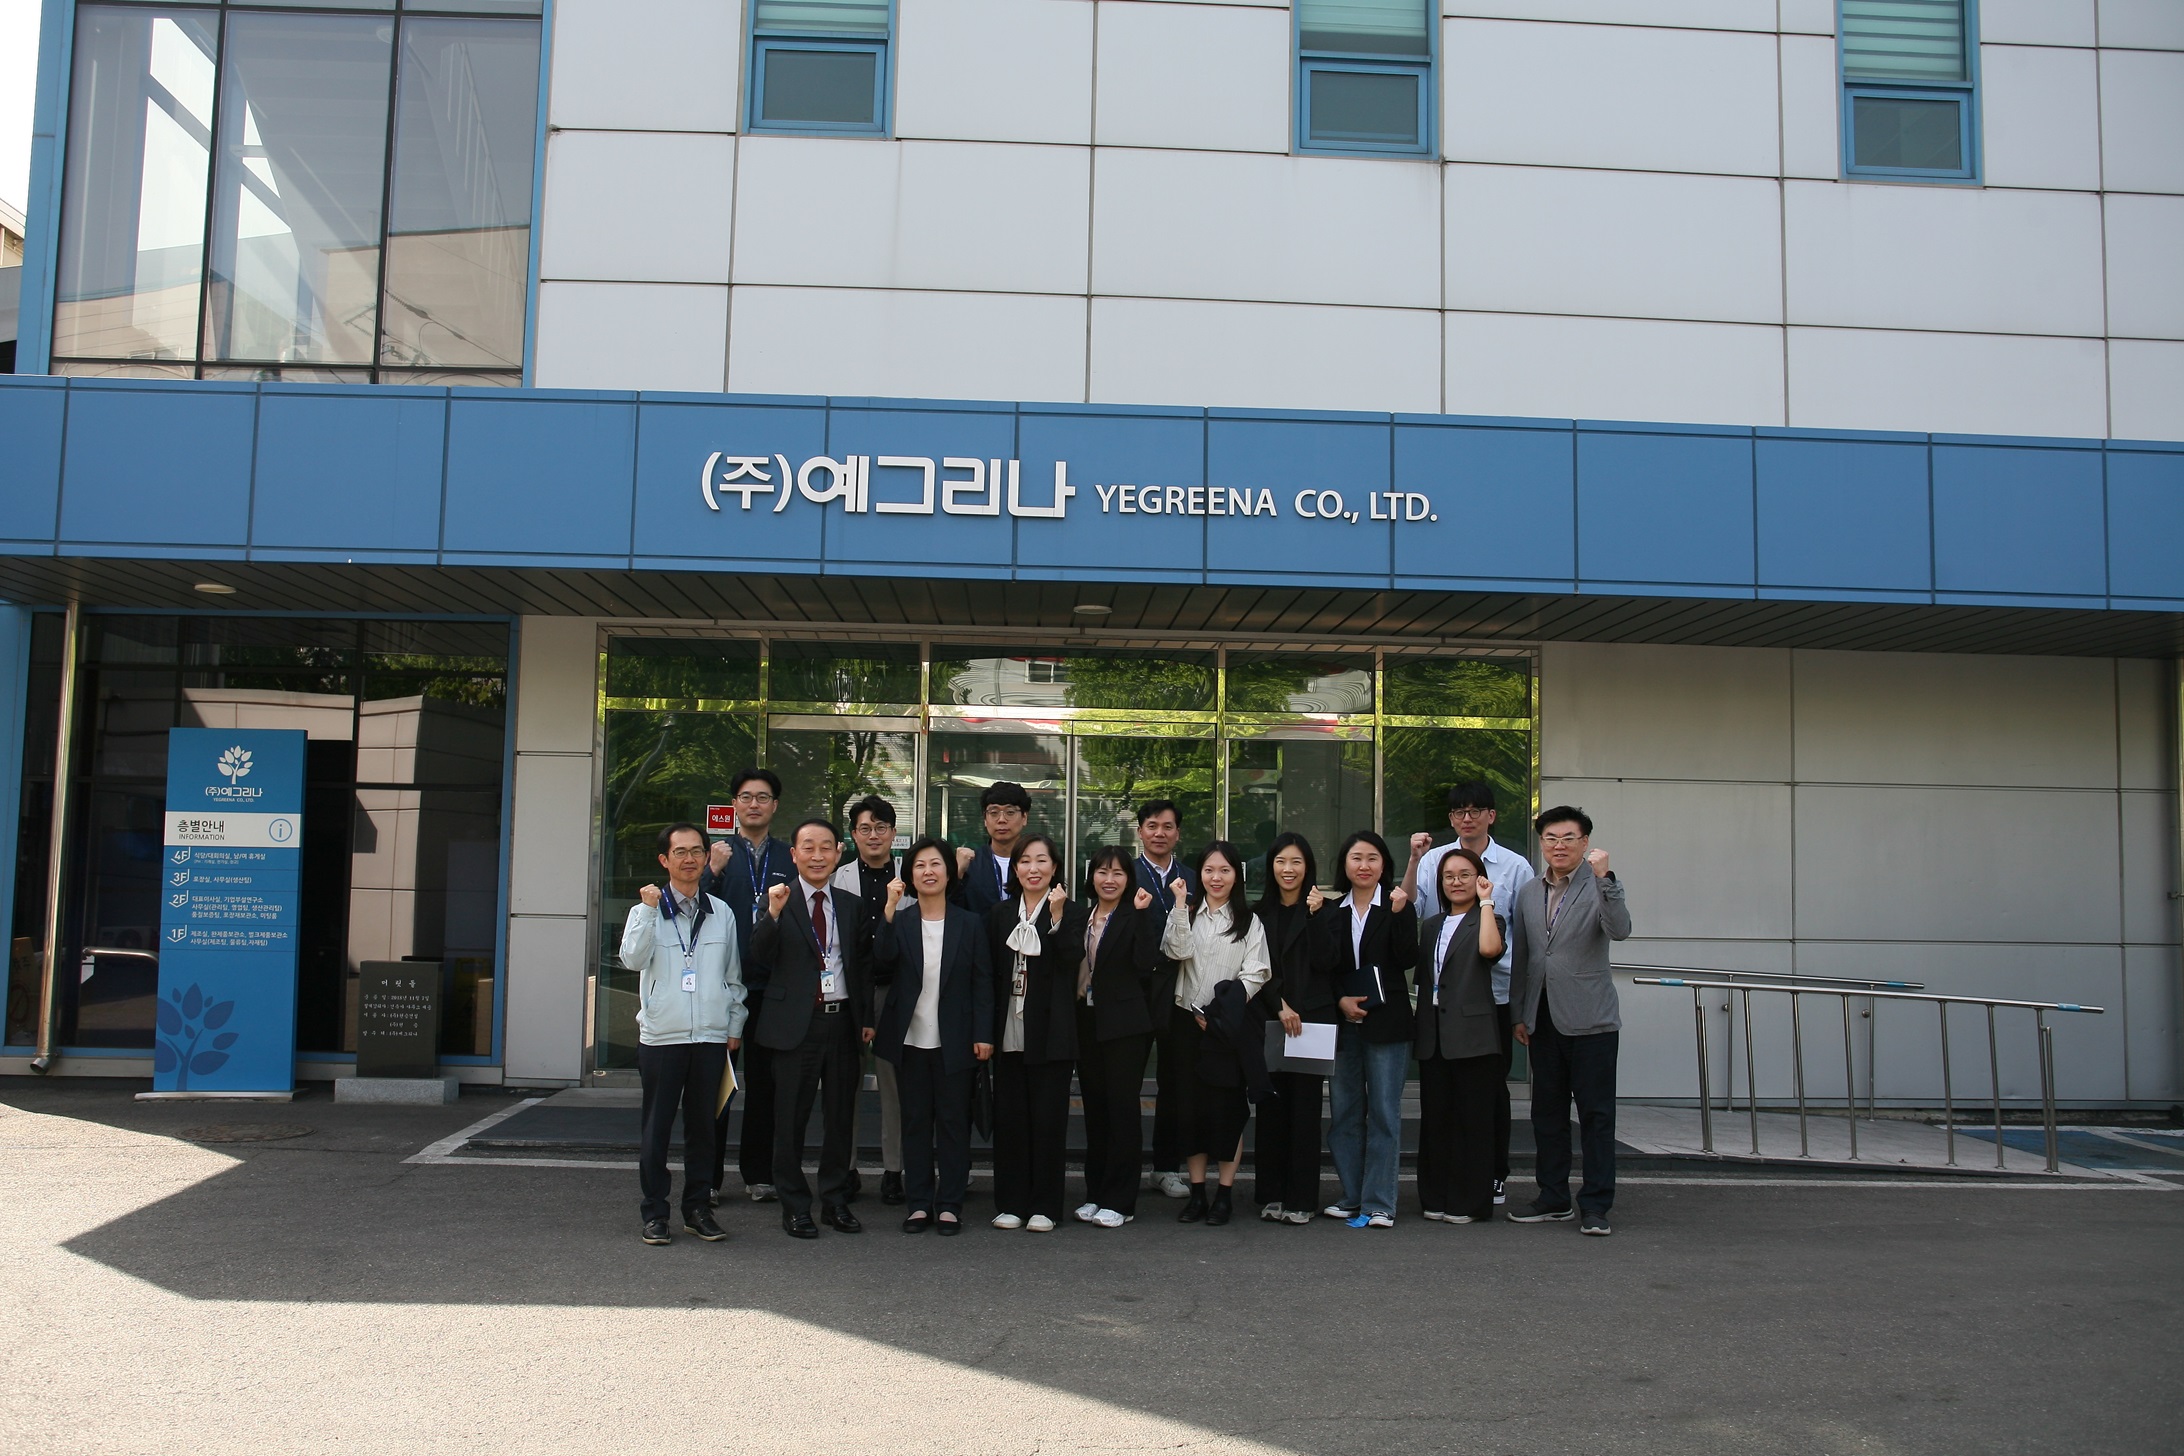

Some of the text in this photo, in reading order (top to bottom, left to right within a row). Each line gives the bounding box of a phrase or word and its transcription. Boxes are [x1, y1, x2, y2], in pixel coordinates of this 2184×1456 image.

[701, 451, 1076, 519] (주)예그리나
[1095, 484, 1438, 524] YEGREENA CO., LTD.
[205, 787, 263, 797] (주)예그리나
[711, 814, 731, 823] 에스원
[177, 820, 225, 833] 층별안내
[178, 833, 225, 841] INFORMATION
[174, 850, 188, 860] 4F
[248, 853, 266, 861] 휴게실
[173, 872, 188, 882] 3F
[172, 894, 186, 904] 2F
[171, 928, 185, 938] 1F
